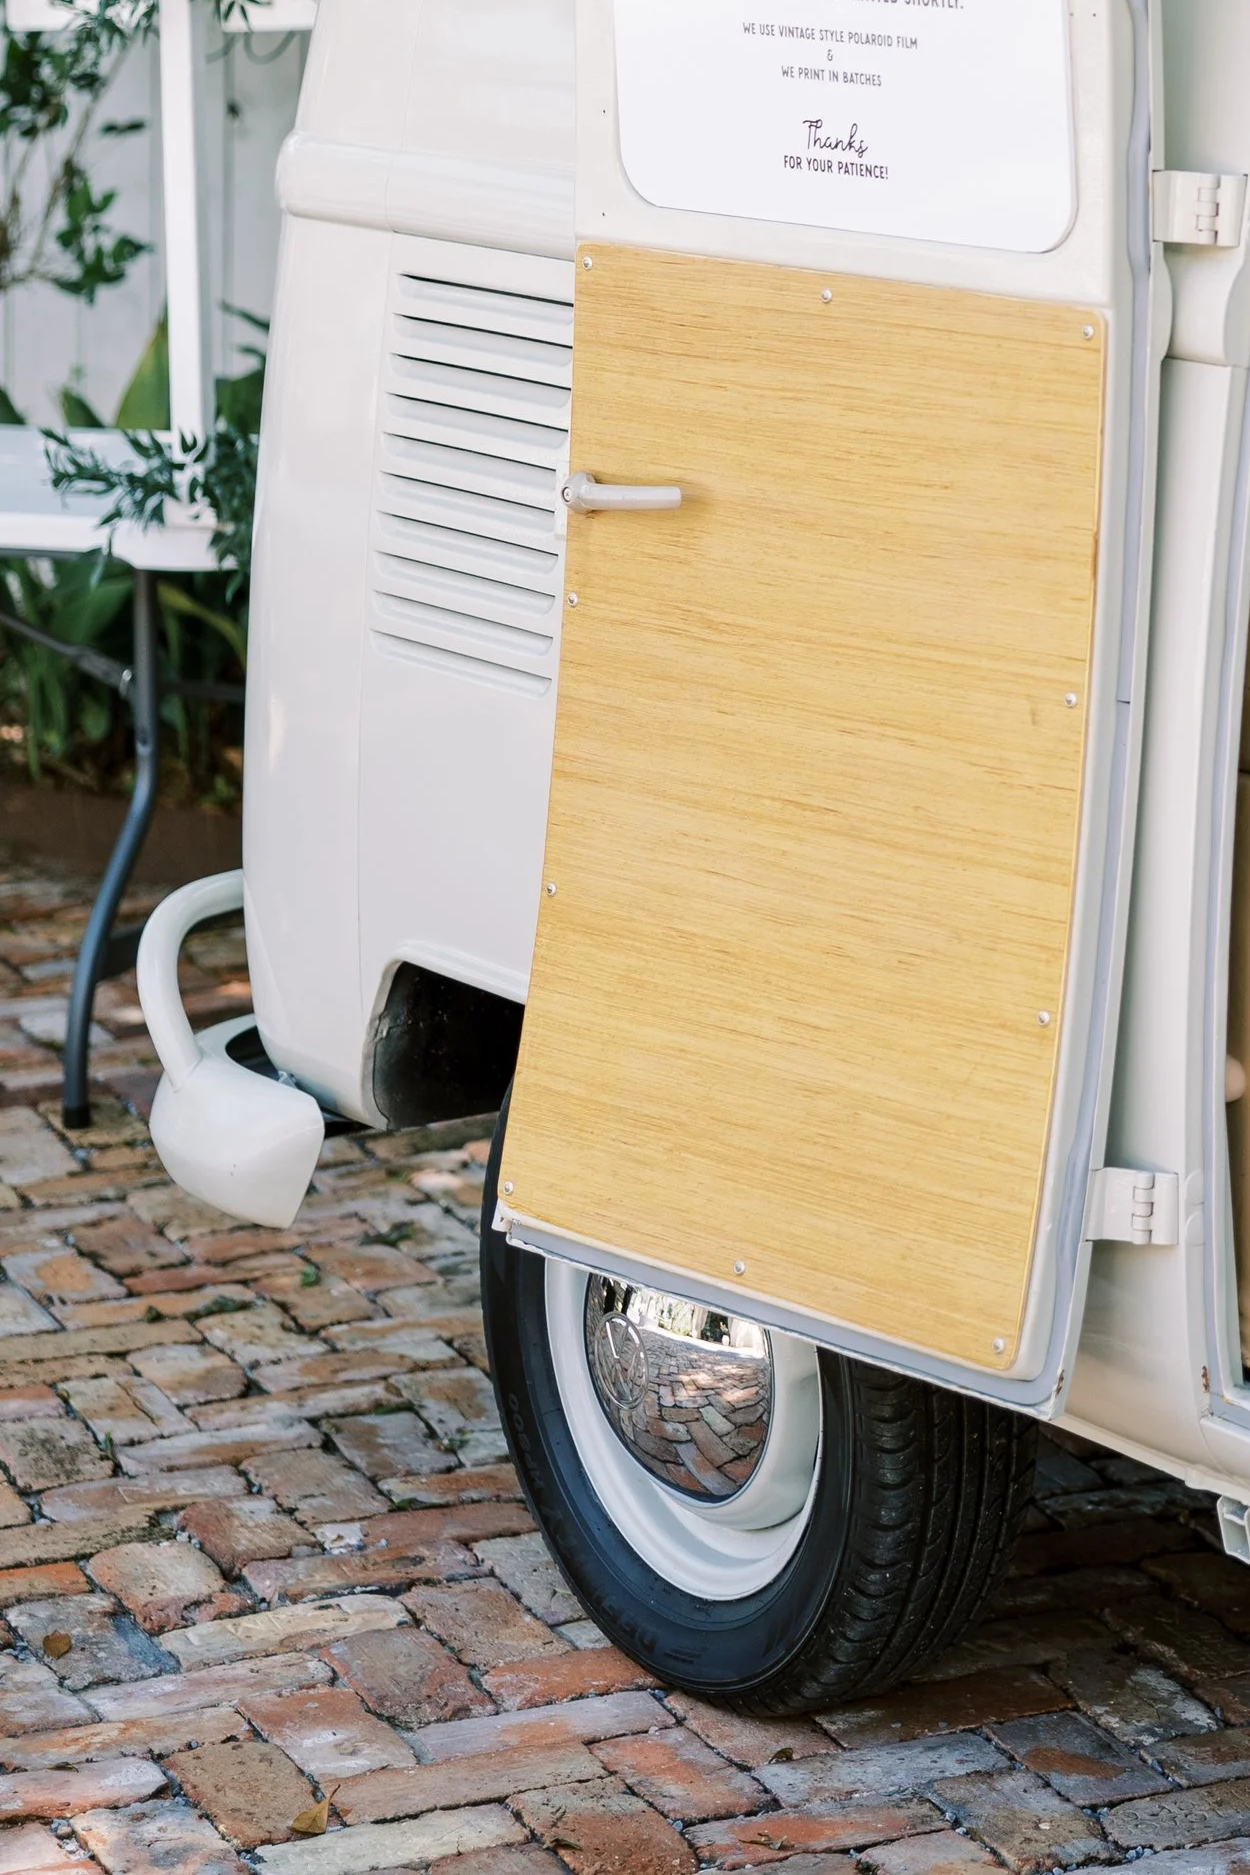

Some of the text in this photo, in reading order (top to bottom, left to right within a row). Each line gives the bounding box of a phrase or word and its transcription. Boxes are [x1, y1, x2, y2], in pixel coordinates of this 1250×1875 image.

[742, 21, 918, 50] WE USE VINTAGE STYLE POLAROID FILM
[780, 65, 882, 87] WE PRINT IN BATCHES
[802, 118, 869, 159] Thanks
[783, 154, 889, 180] FOR YOUR PATIENCE!
